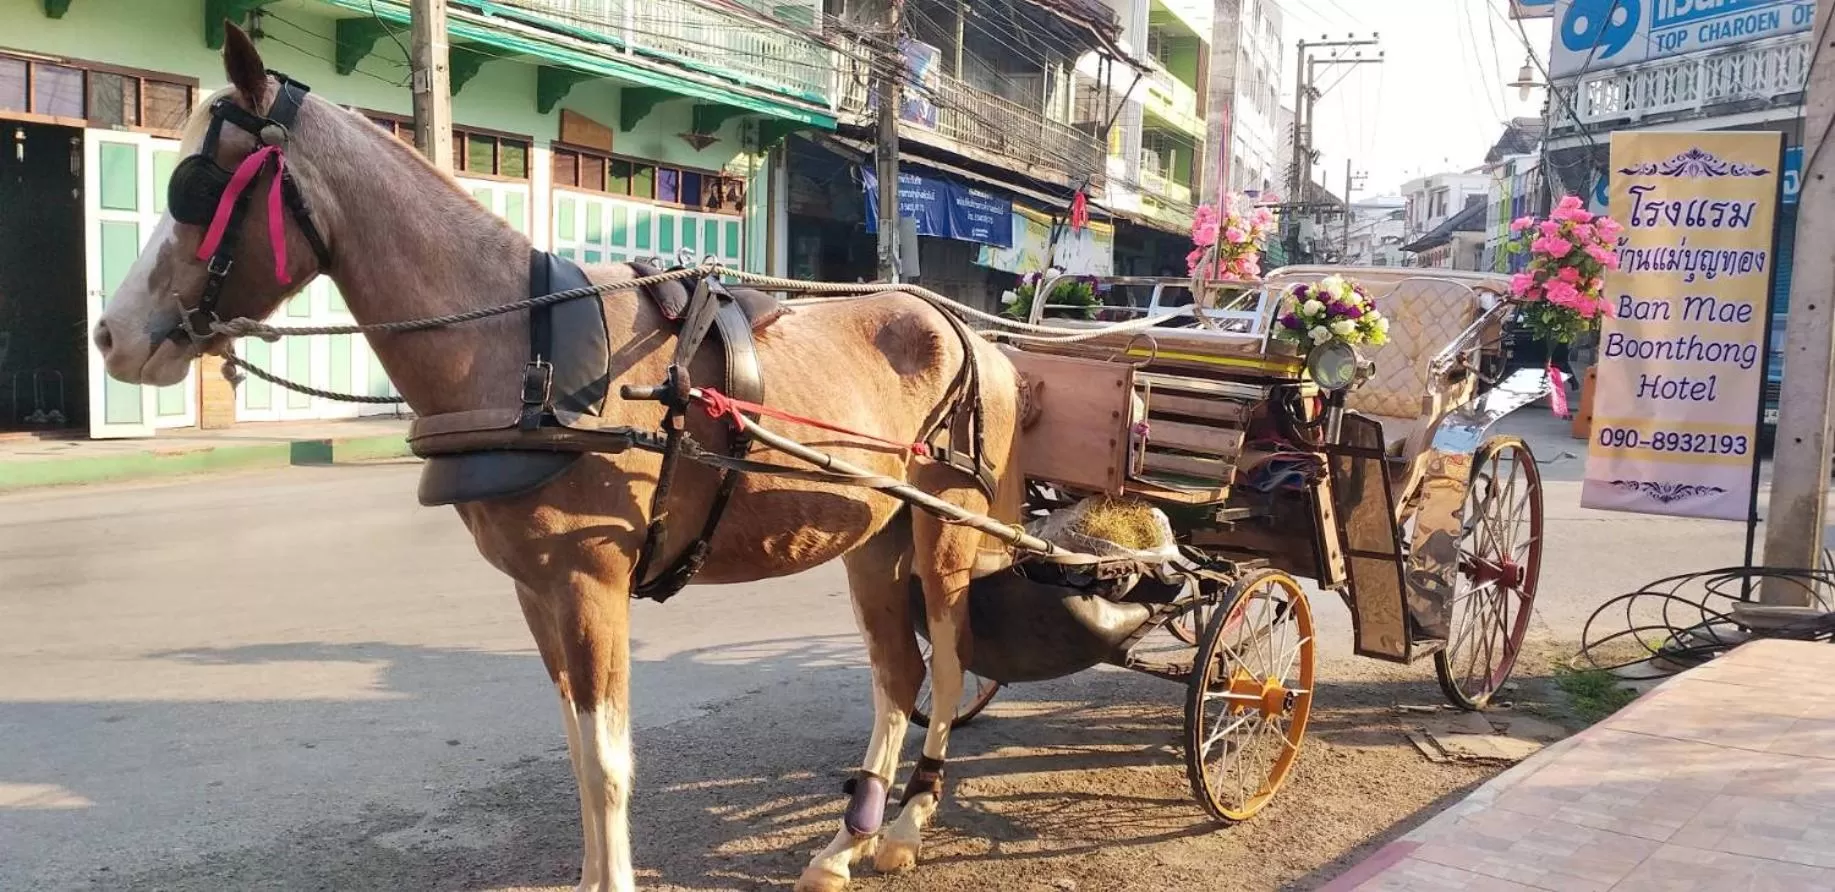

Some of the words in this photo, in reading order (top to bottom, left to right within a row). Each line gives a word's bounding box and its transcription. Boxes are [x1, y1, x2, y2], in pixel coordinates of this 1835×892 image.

[1656, 29, 1688, 52] TOP
[1698, 9, 1780, 43] CHAROEN
[1628, 185, 1756, 228] โรงแรม
[1618, 294, 1671, 321] Ban
[1683, 296, 1753, 323] Mae
[1605, 333, 1758, 370] Boonthong
[1636, 374, 1717, 402] Hotel
[1600, 427, 1748, 455] 090-8932193
